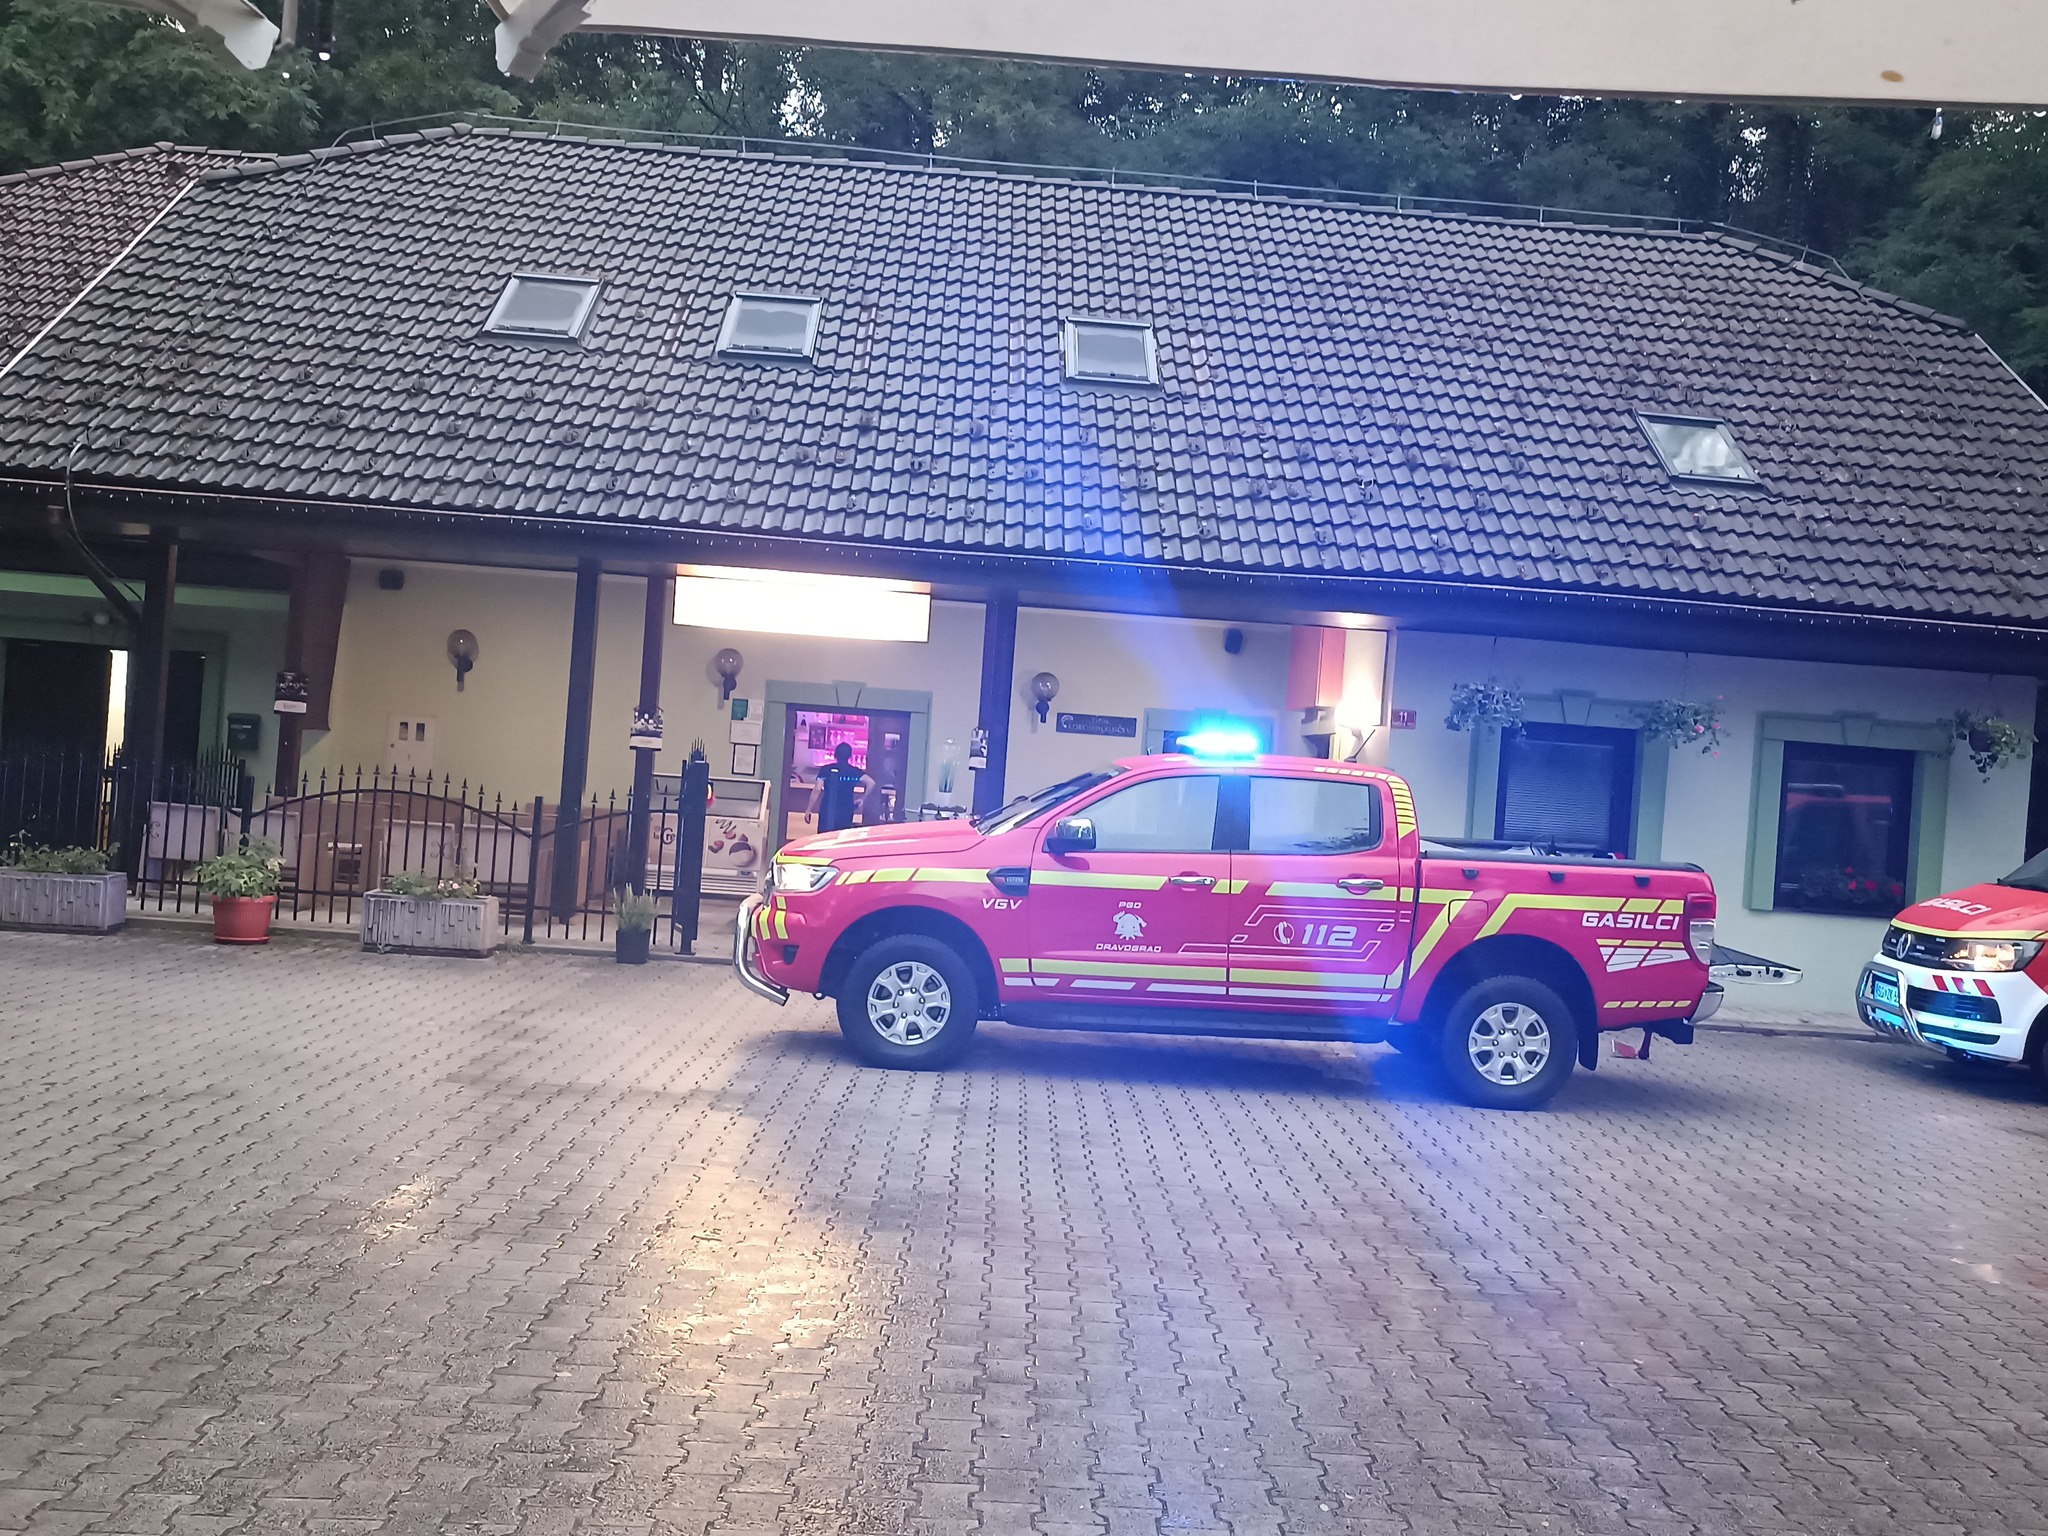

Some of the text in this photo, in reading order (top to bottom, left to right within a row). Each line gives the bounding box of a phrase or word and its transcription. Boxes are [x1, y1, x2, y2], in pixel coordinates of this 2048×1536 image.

[981, 897, 1023, 910] VGV
[1118, 901, 1142, 909] PGD
[1919, 898, 1992, 915] GASILCI
[1582, 912, 1680, 930] GASILCI
[1301, 923, 1358, 947] 112
[1095, 943, 1162, 953] DRAVOGRAD
